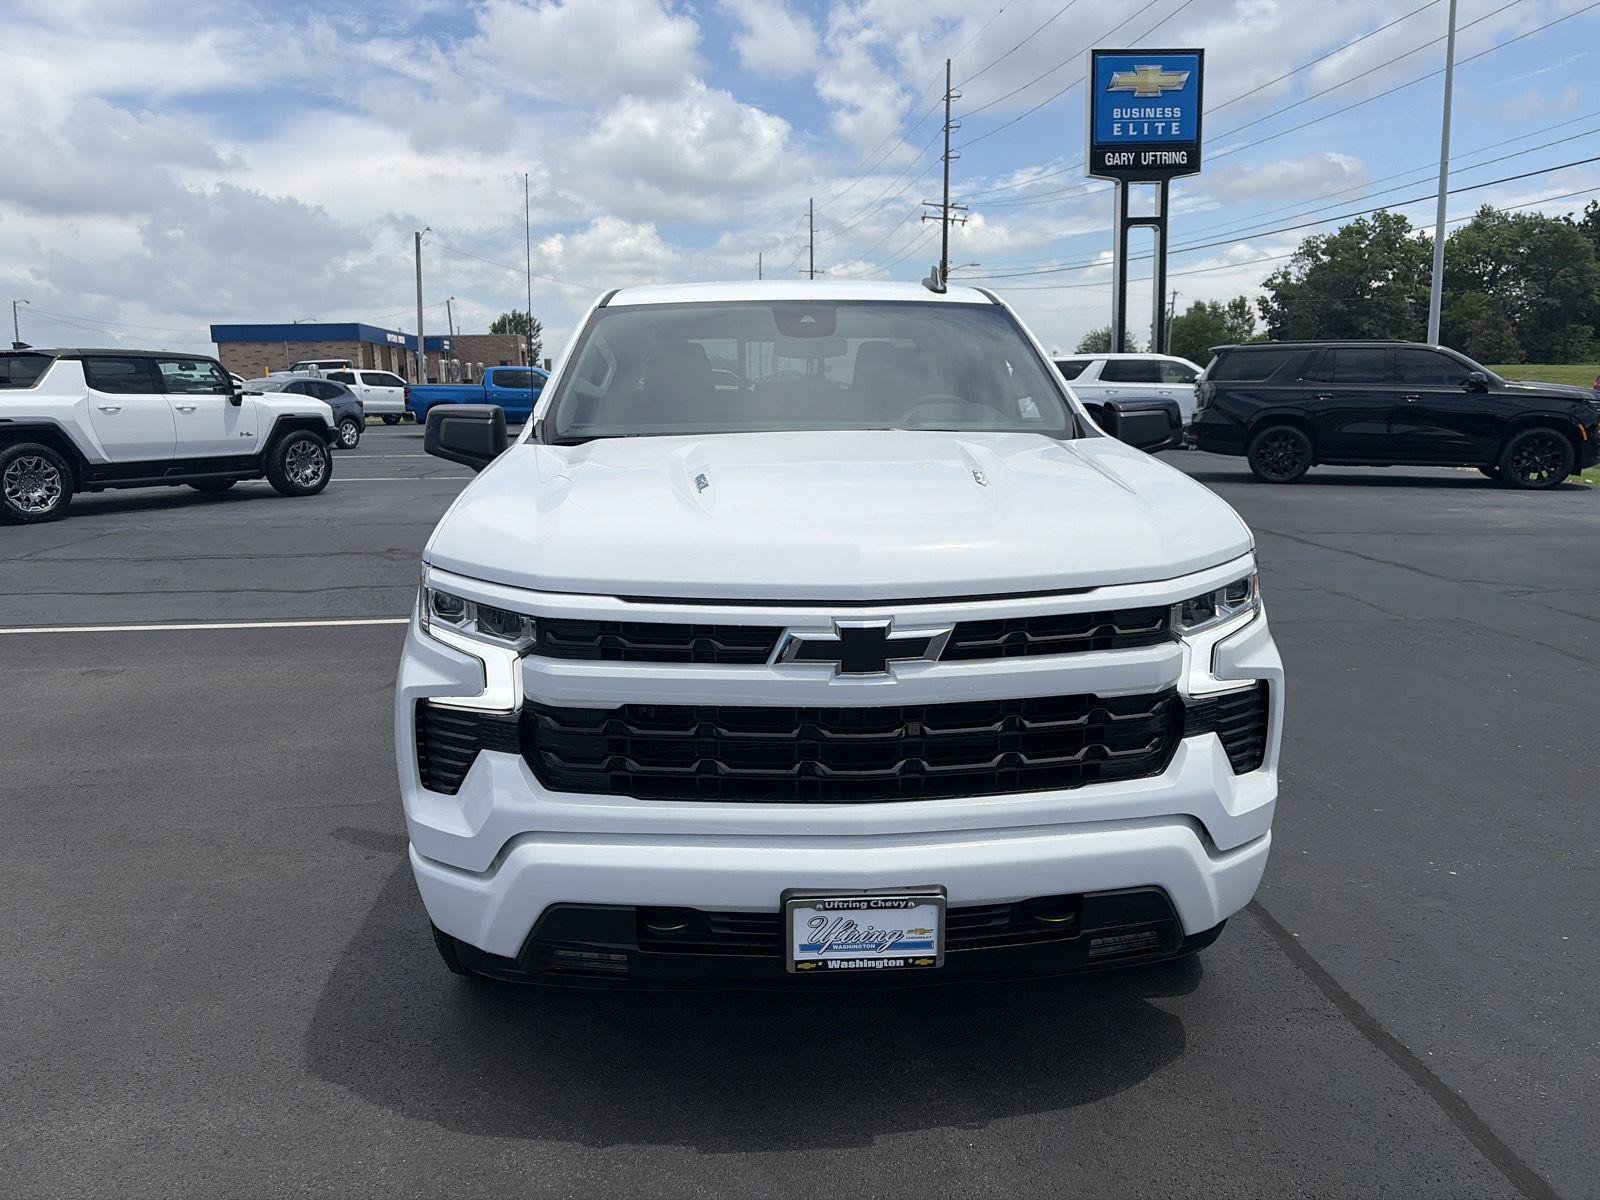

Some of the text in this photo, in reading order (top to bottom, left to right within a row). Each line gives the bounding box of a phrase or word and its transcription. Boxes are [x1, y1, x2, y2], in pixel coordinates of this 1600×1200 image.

[1113, 108, 1181, 118] BUSINESS
[1113, 123, 1180, 135] ELITE
[1105, 151, 1187, 165] GARY UFTRING
[825, 900, 907, 909] Uftring Chevy
[807, 916, 904, 955] Uftring
[827, 959, 904, 969] Washington
